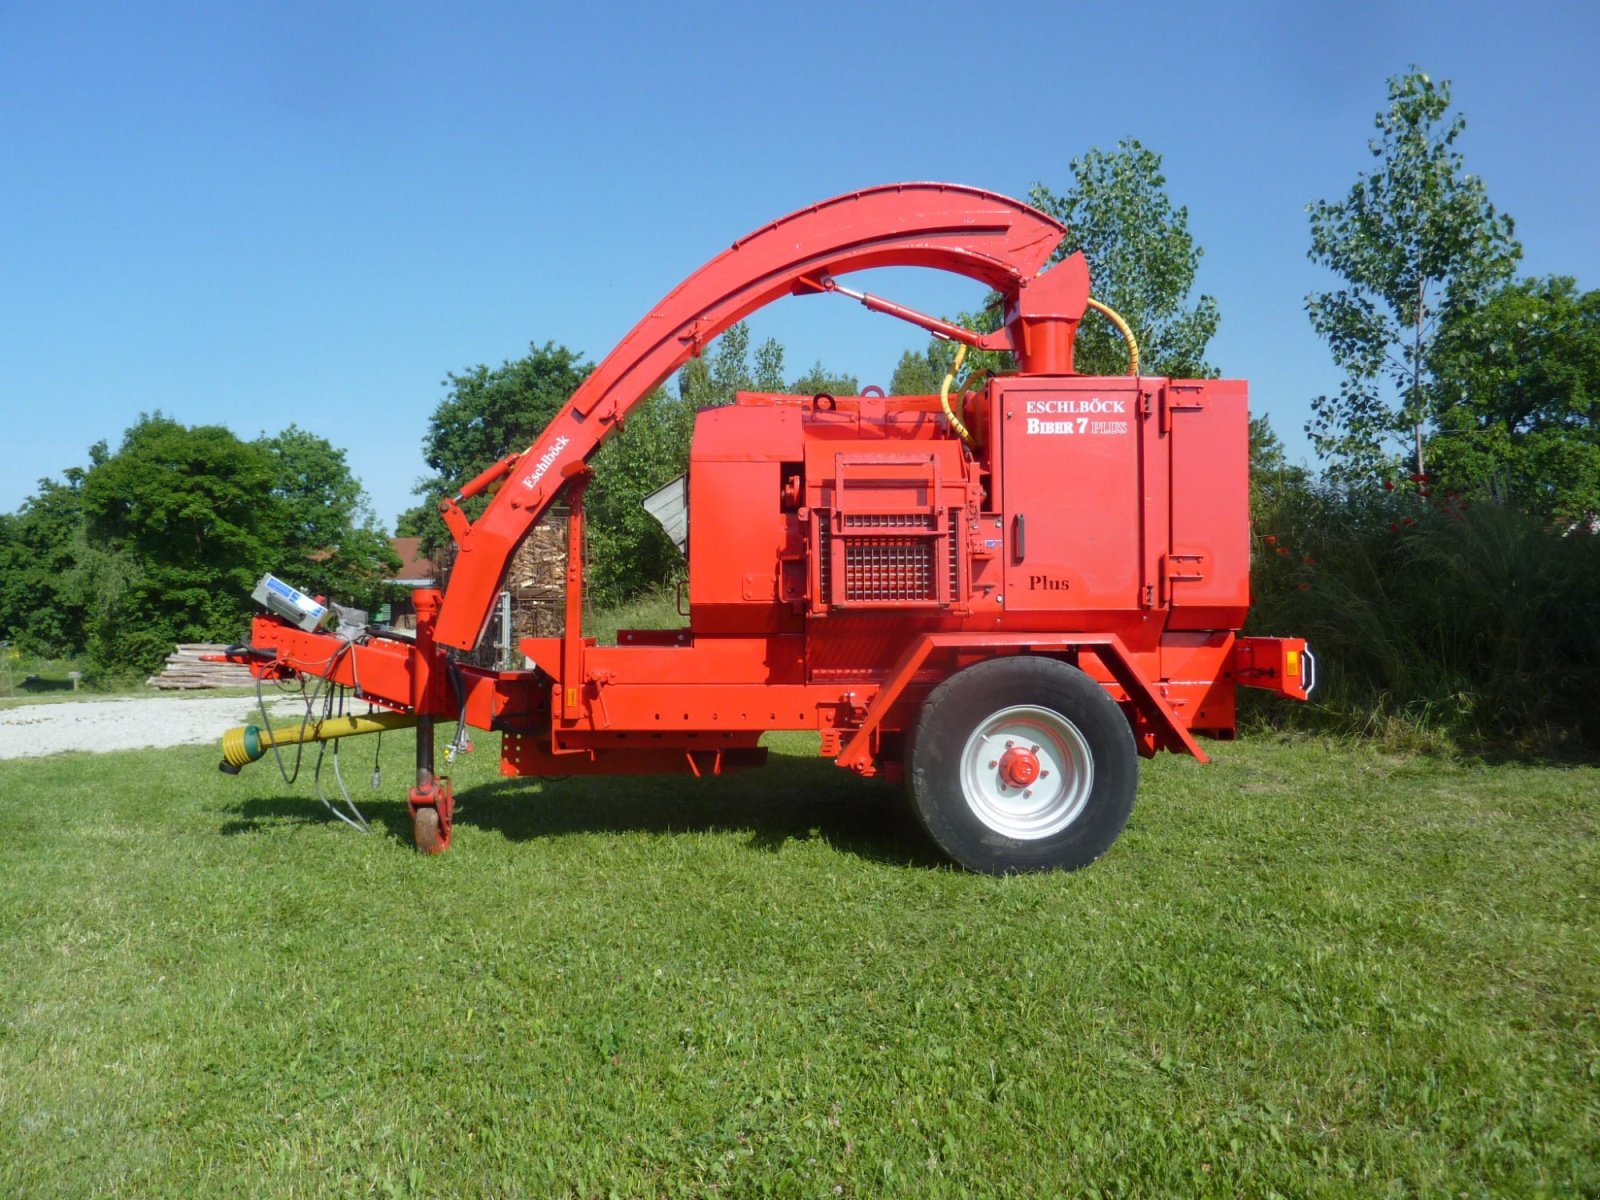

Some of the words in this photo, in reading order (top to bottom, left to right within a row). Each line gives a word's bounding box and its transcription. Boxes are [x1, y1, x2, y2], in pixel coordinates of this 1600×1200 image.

[1026, 398, 1126, 414] ESCHLBÖCK
[1026, 418, 1074, 435] BIBER
[1076, 417, 1089, 434] 7
[1091, 421, 1128, 434] PLUS
[522, 436, 570, 490] Eschlböck
[1029, 575, 1070, 590] Plus
